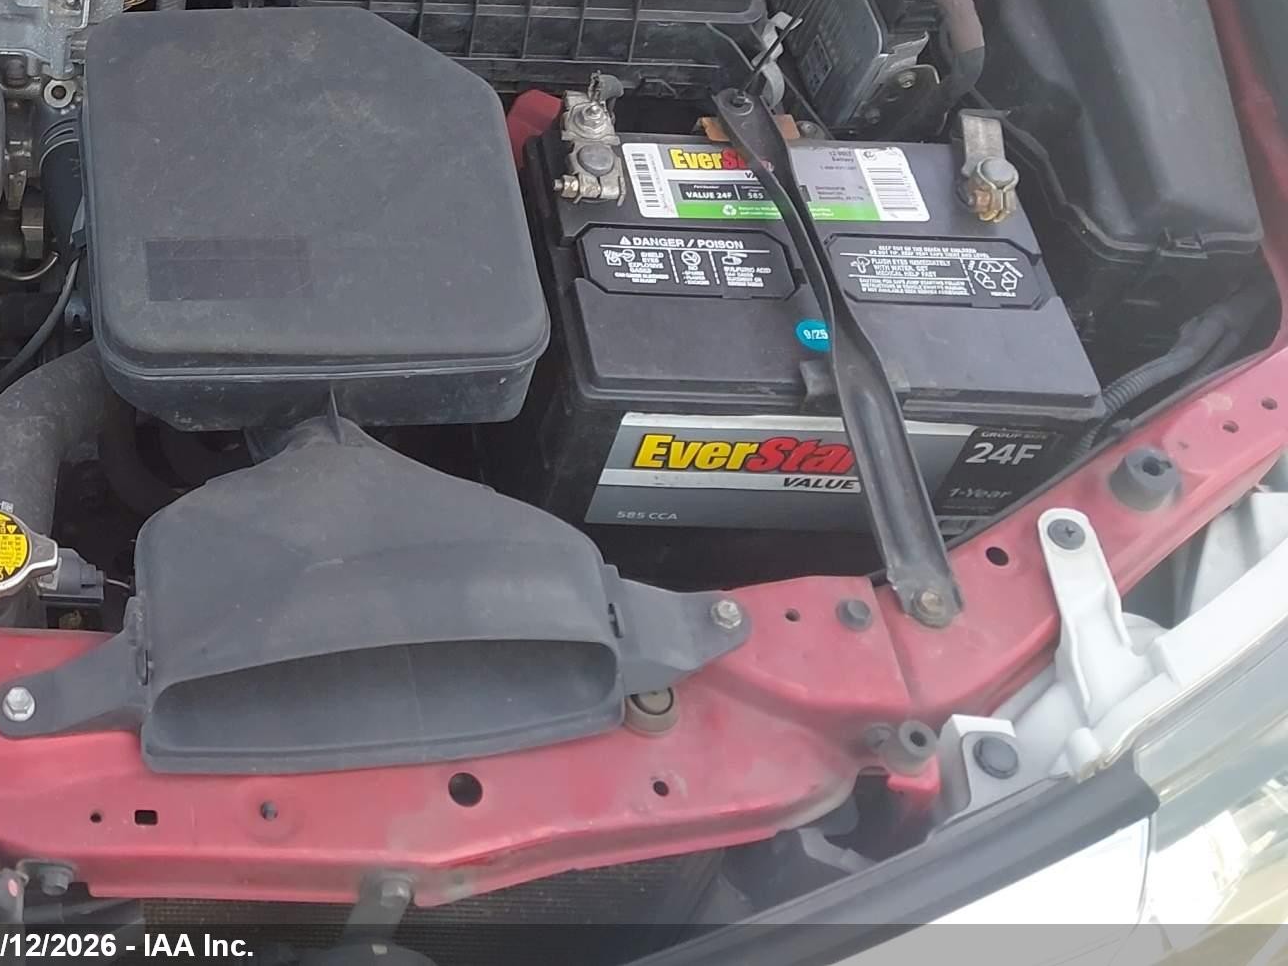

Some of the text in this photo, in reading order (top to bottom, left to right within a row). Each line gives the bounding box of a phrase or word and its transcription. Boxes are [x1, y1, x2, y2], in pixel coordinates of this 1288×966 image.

[686, 191, 715, 199] VALUE
[632, 237, 685, 247] DANGER
[697, 239, 744, 249] POISON
[803, 329, 829, 340] 9/25
[965, 442, 1043, 466] 24F
[784, 477, 860, 490] VALUE
[616, 510, 678, 521] 585 CCA
